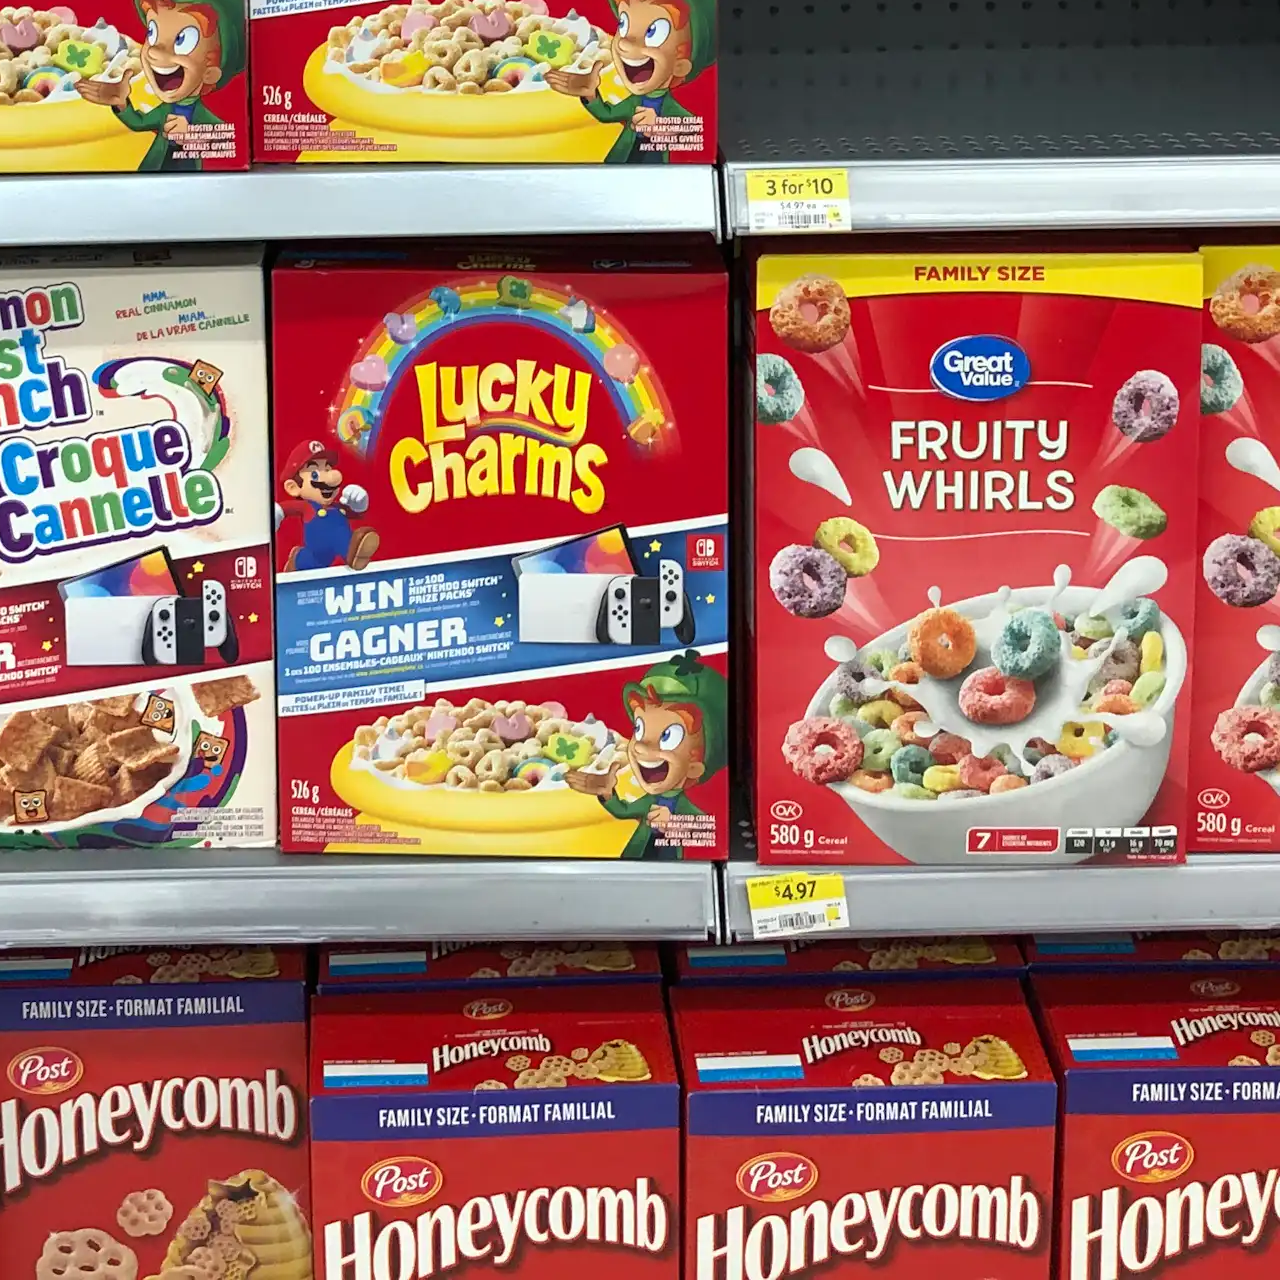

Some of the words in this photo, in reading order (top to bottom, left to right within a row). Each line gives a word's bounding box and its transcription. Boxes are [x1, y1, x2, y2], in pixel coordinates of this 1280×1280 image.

[263, 86, 281, 105] 526
[284, 91, 292, 110] g
[766, 179, 776, 196] 3
[782, 179, 804, 194] for
[806, 178, 833, 194] $10
[914, 265, 990, 282] FAMILY
[997, 265, 1045, 281] SIZE
[943, 349, 1014, 374] Great
[960, 370, 1013, 388] Value
[414, 359, 591, 446] Lucky
[891, 419, 1069, 461] FRUITY
[0, 424, 185, 496] Croque
[389, 431, 609, 514] Charms
[882, 469, 1075, 512] WHIRLS
[324, 579, 403, 616] WIN
[310, 617, 467, 662] GAGNER
[769, 824, 800, 846] 580
[803, 828, 815, 849] g
[818, 835, 848, 846] Cereal
[774, 881, 816, 900] $4.97
[432, 1032, 551, 1073] Honeycomb
[802, 1025, 921, 1065] Honeycomb
[19, 1055, 70, 1086] Post
[378, 1106, 434, 1128] FAMILY
[437, 1106, 470, 1126] SIZE
[479, 1103, 540, 1125] FORMAT
[544, 1100, 616, 1122] FAMILIAL
[1125, 1140, 1183, 1173] Post
[374, 1165, 432, 1193] Post
[750, 1160, 807, 1193] Post
[324, 1176, 666, 1280] Honeycomb
[697, 1175, 1039, 1280] Honeycomb
